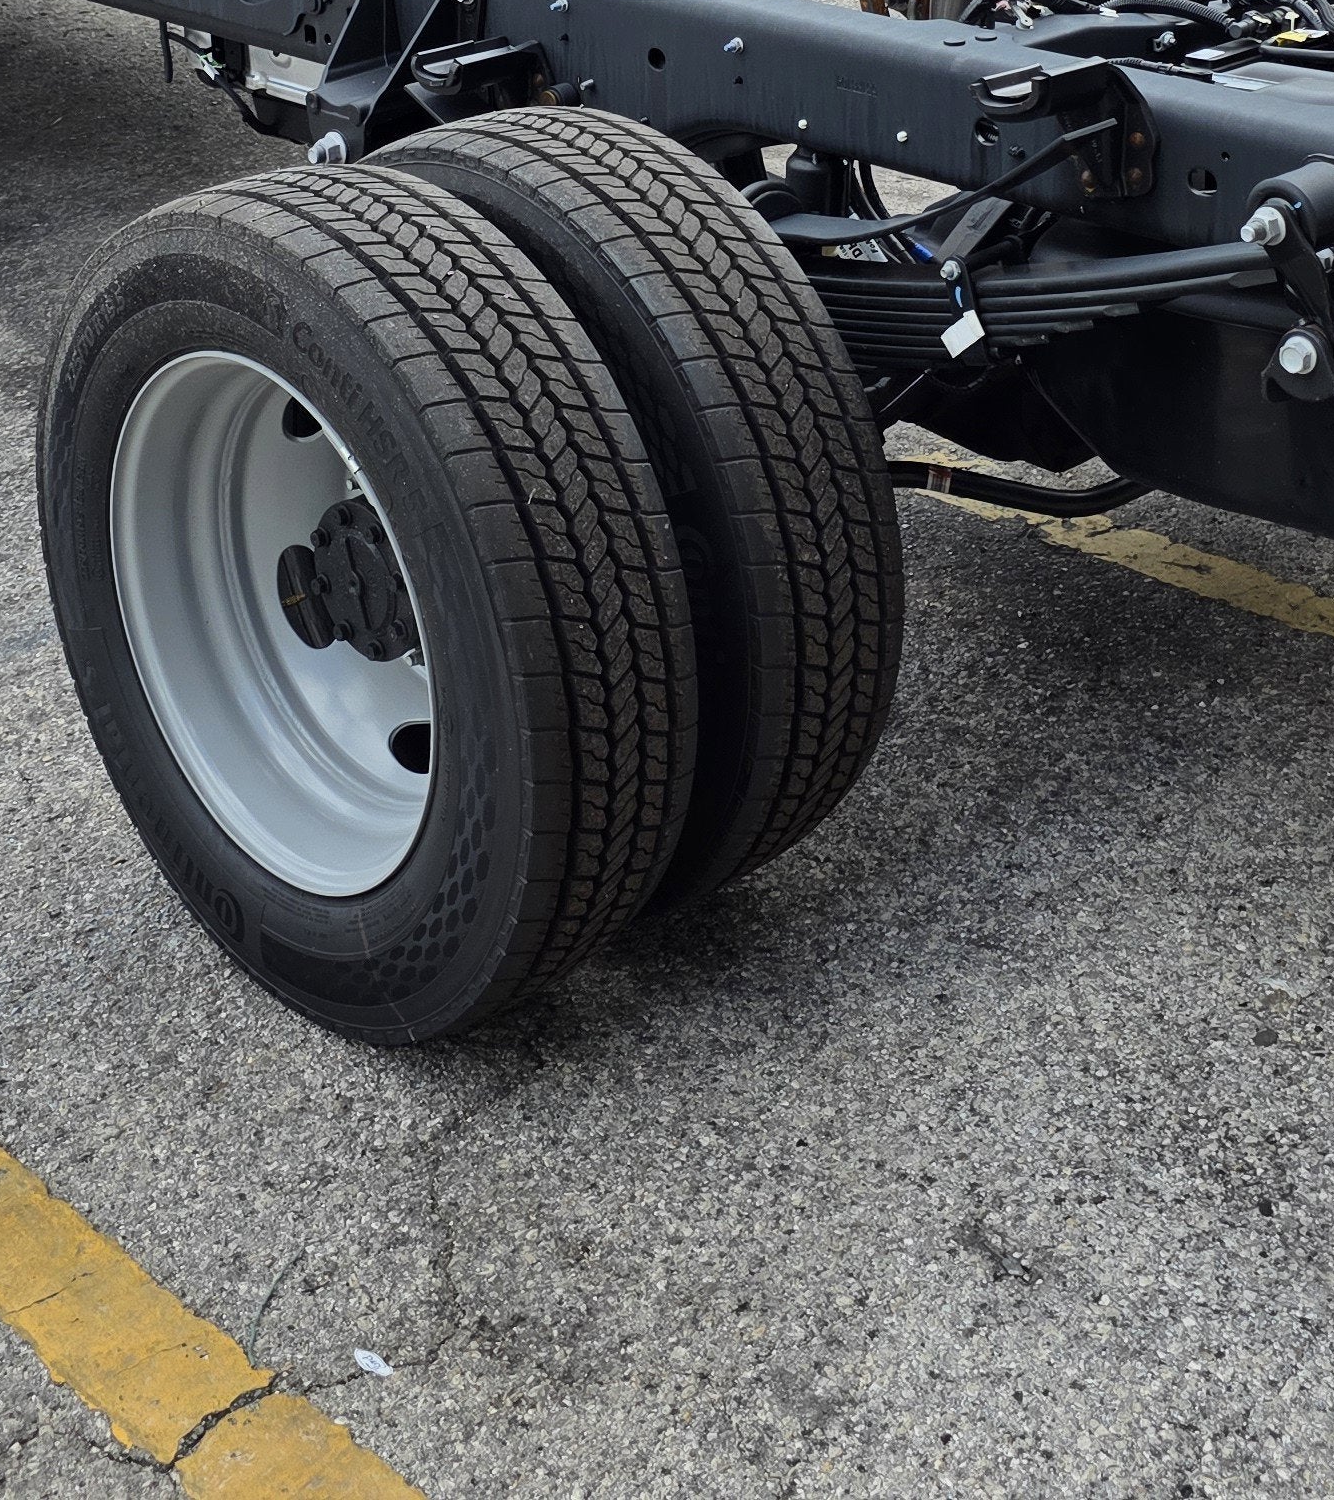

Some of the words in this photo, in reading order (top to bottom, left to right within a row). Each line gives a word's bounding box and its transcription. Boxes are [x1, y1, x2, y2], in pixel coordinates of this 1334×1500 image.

[291, 320, 364, 408] Conti
[354, 400, 412, 484] HSR
[91, 702, 248, 944] Continental
